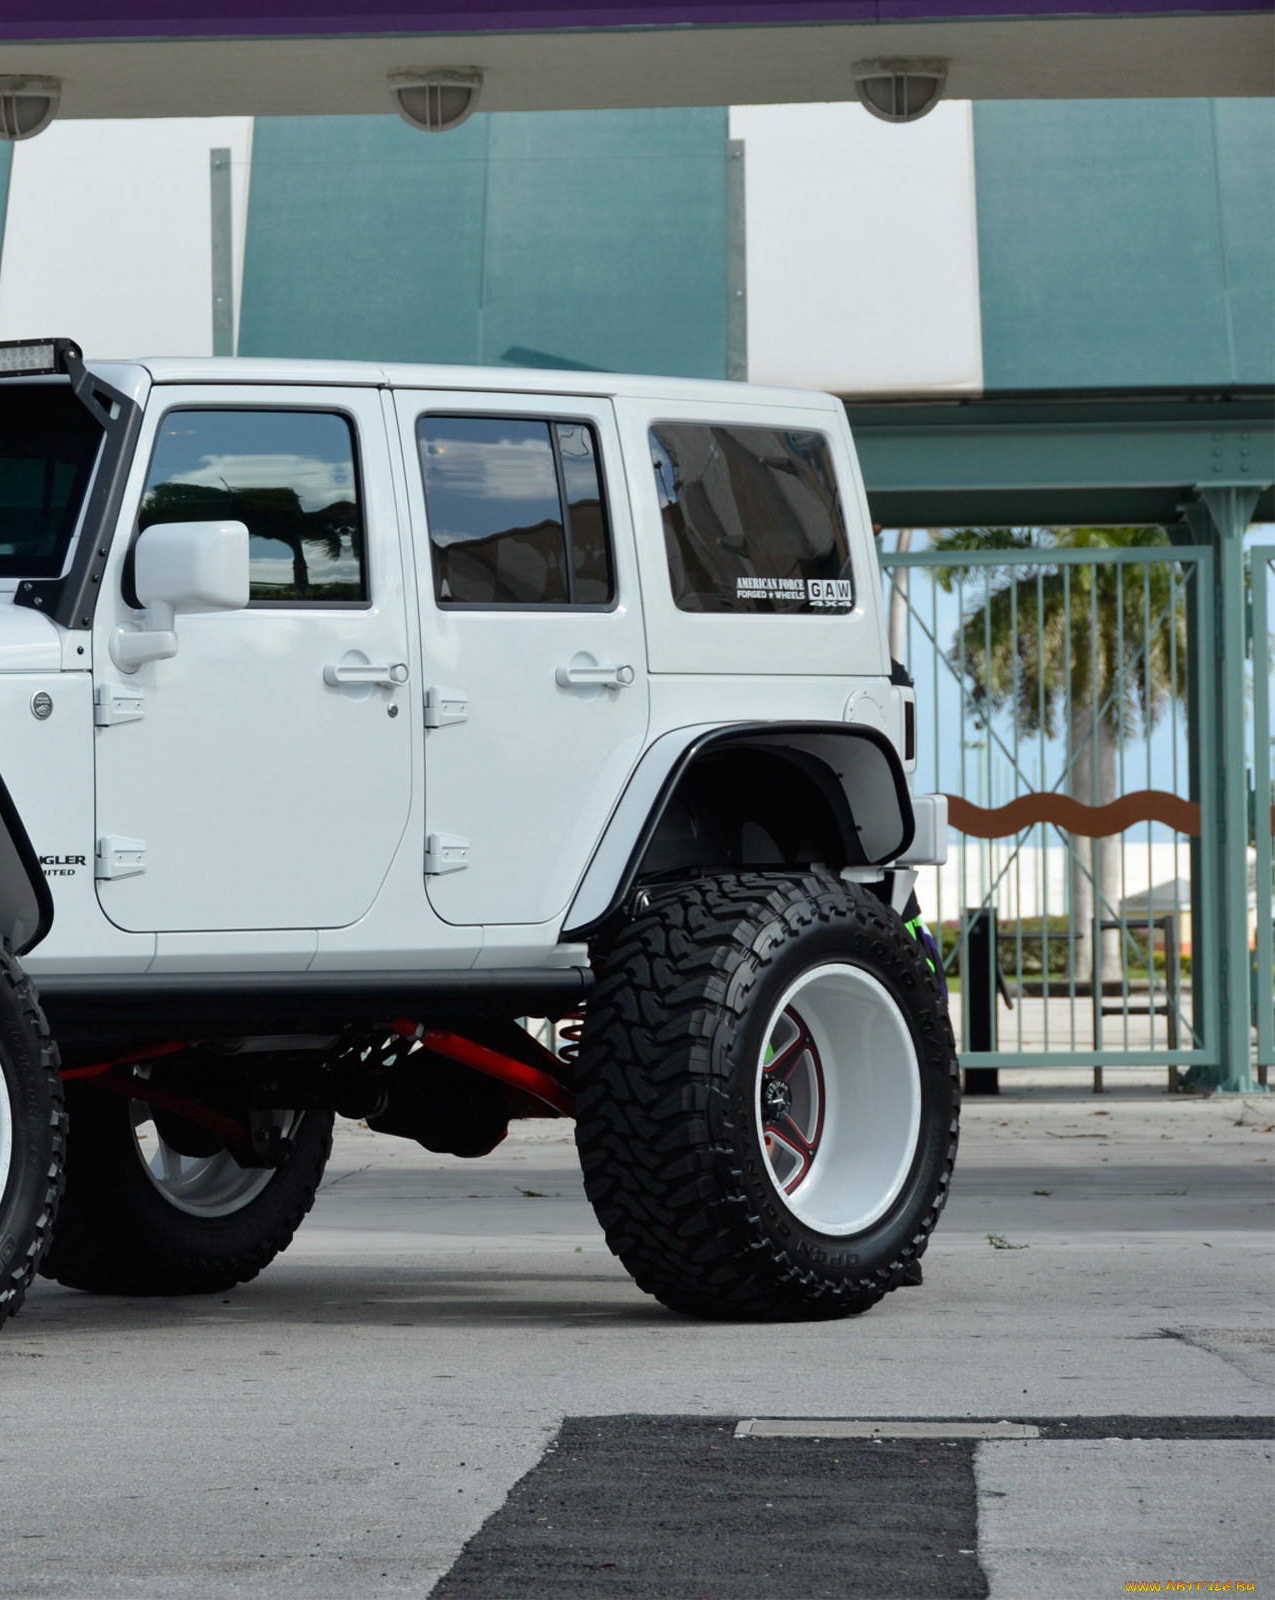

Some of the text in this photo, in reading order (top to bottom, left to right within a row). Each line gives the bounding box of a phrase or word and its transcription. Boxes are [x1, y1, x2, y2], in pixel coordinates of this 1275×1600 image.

[737, 577, 805, 591] AMERICAN FORCE
[809, 581, 851, 600] GAW
[737, 590, 805, 600] FORGED WHEELS
